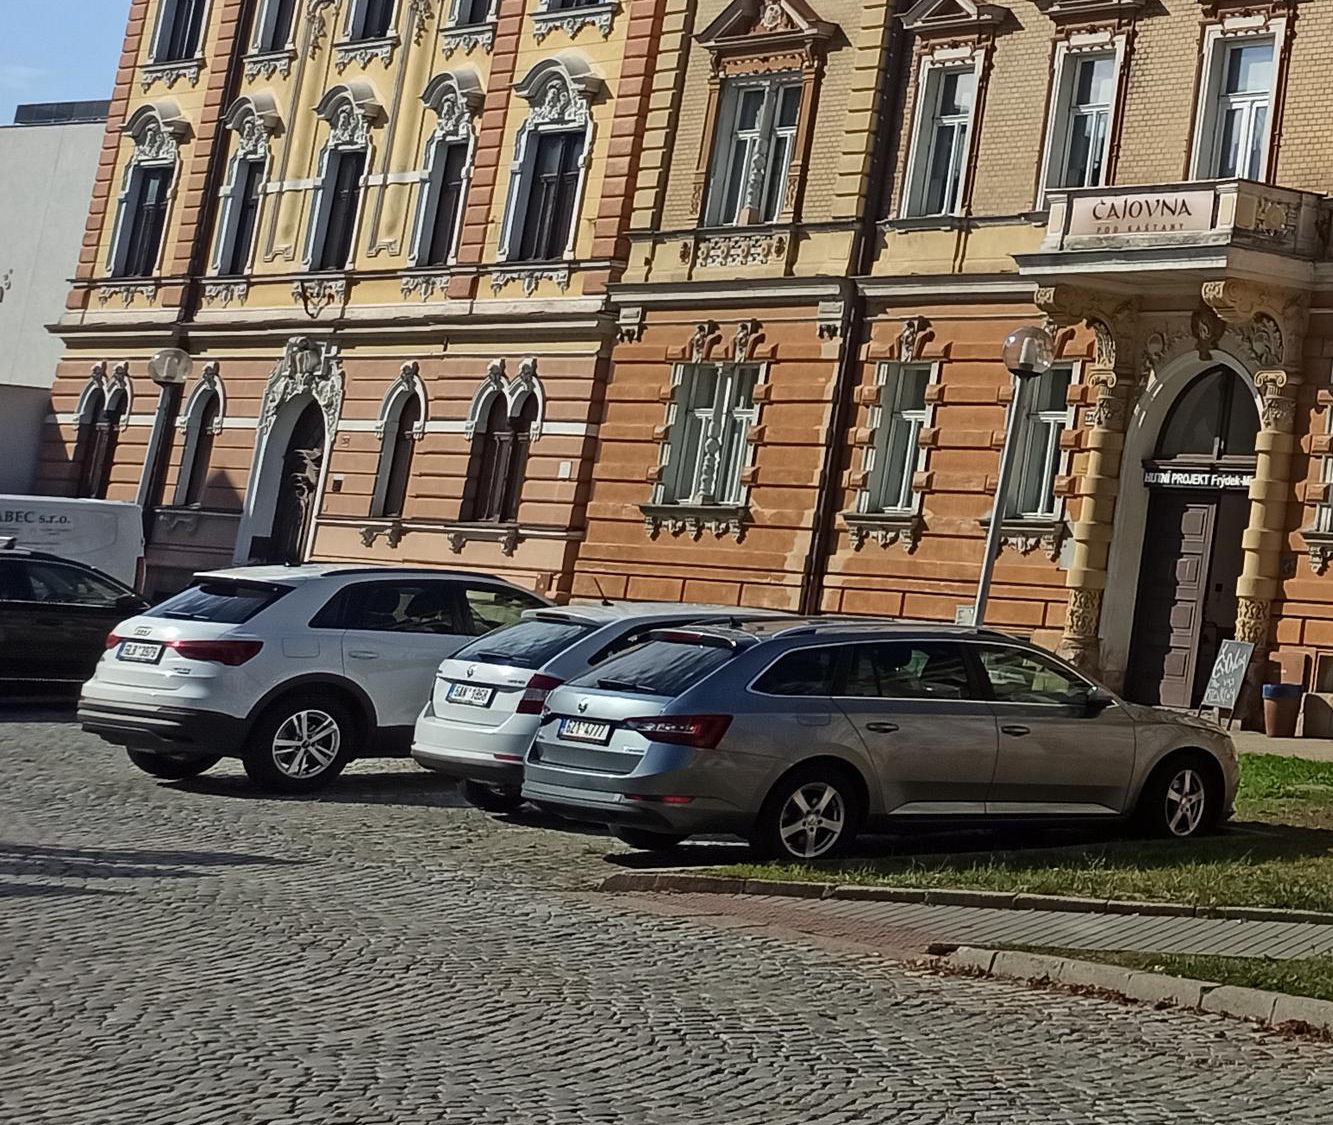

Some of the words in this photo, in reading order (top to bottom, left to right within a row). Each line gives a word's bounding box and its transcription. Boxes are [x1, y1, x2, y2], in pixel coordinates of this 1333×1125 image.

[1092, 198, 1192, 221] ČAJOVNA
[1096, 226, 1119, 234] POD
[1144, 470, 1171, 484] HUTNÍ
[1171, 473, 1210, 485] PROJEKT
[38, 515, 72, 525] s.r.o.
